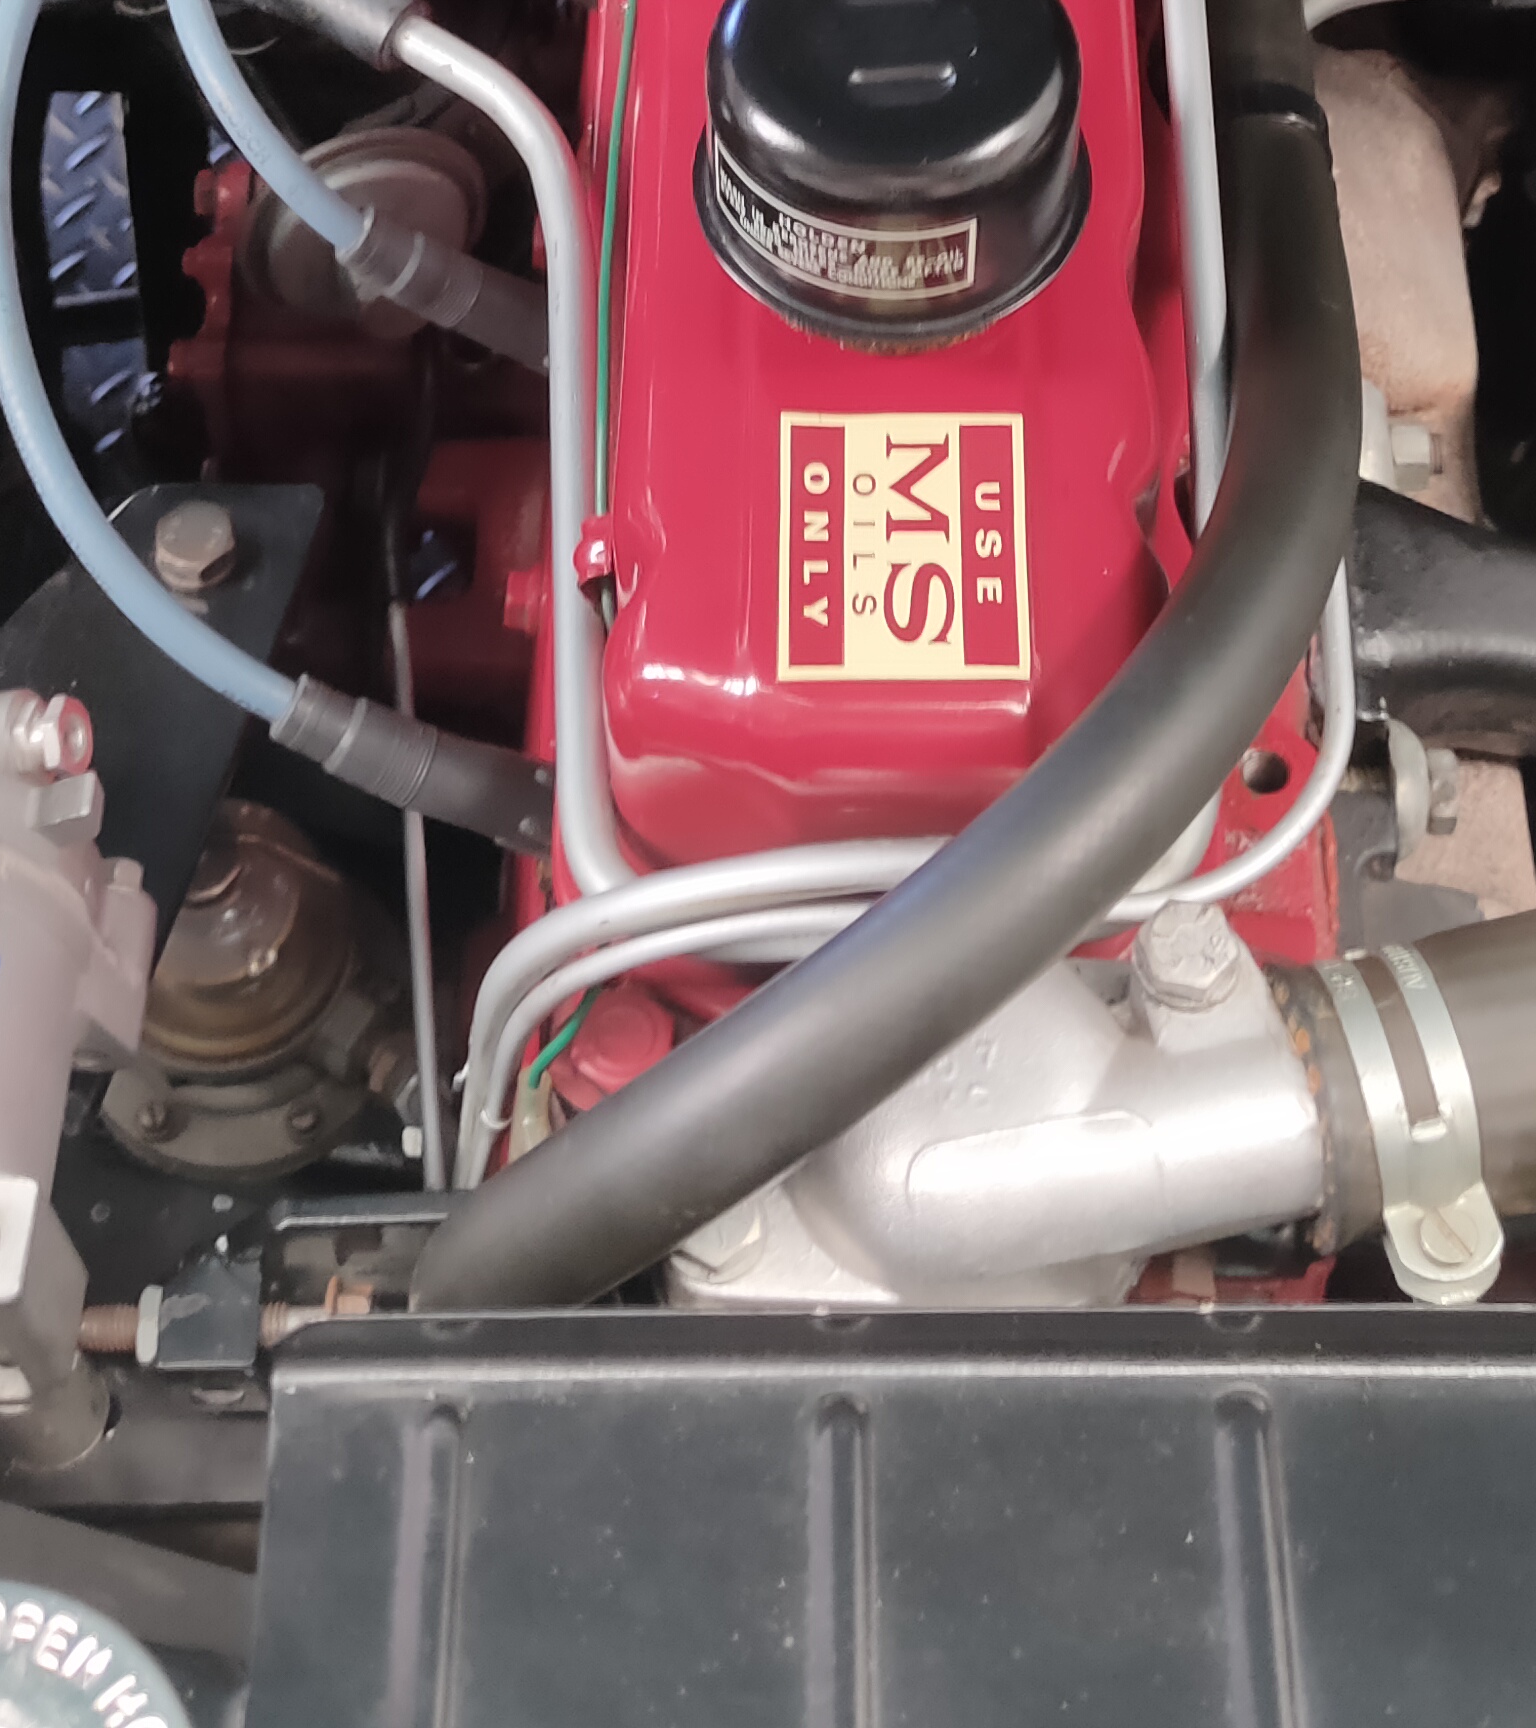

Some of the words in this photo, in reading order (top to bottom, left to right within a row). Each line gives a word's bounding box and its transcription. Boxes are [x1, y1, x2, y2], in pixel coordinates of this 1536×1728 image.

[803, 461, 830, 628] ONLY
[852, 473, 877, 617] OILS
[883, 432, 955, 646] MS
[975, 480, 1003, 604] USE
